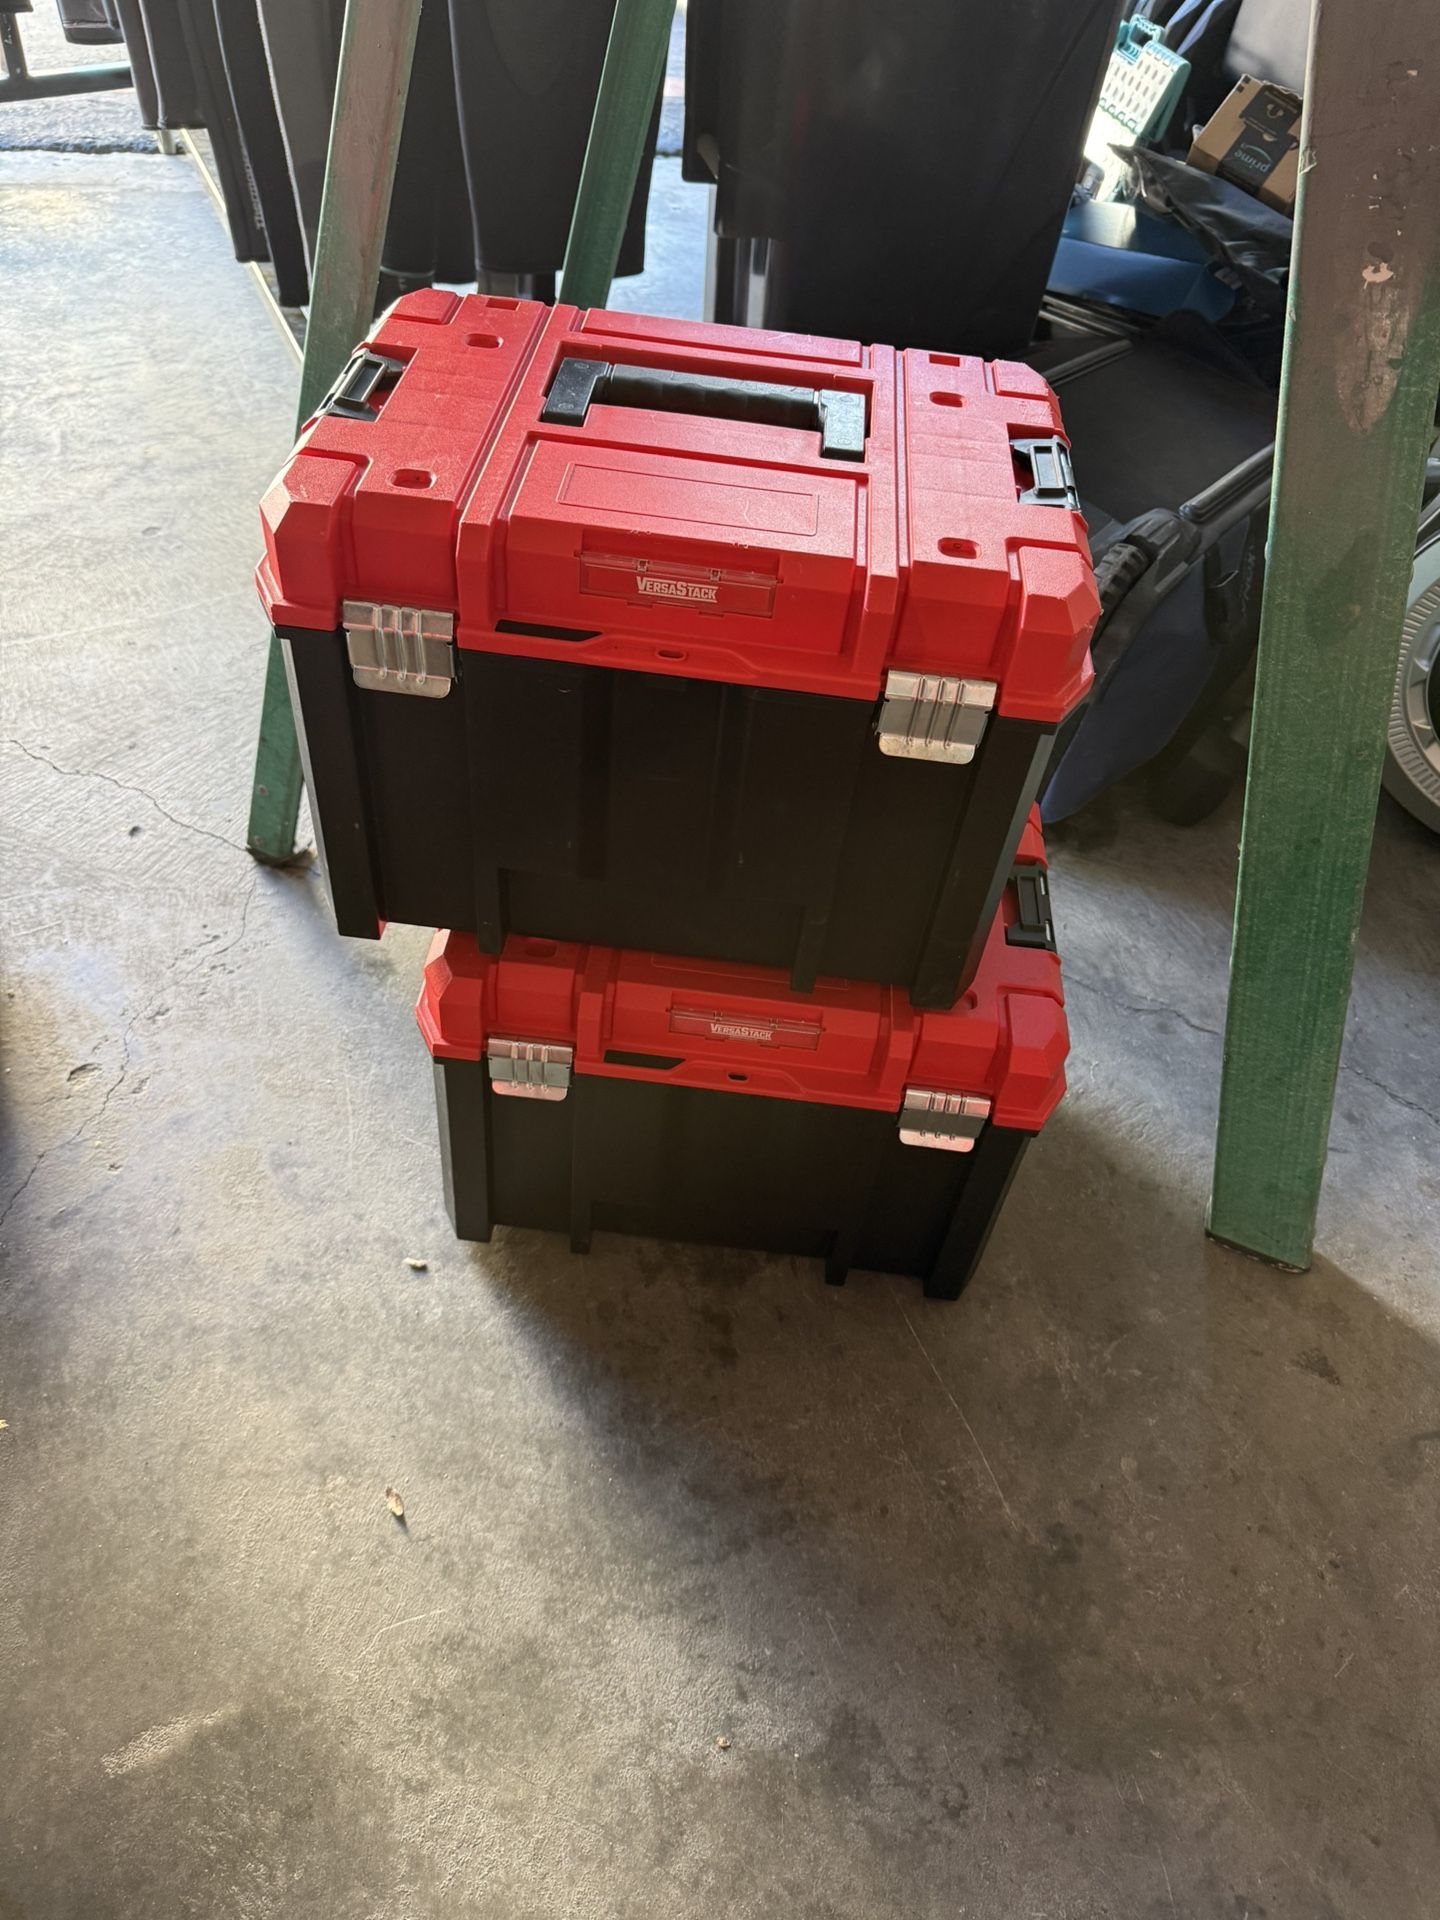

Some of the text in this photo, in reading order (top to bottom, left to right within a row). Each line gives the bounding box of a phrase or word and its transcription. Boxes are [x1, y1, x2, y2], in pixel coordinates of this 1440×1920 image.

[1234, 150, 1271, 172] prime
[636, 576, 718, 603] VERSASTACK
[710, 1023, 774, 1041] VERSASTACK
